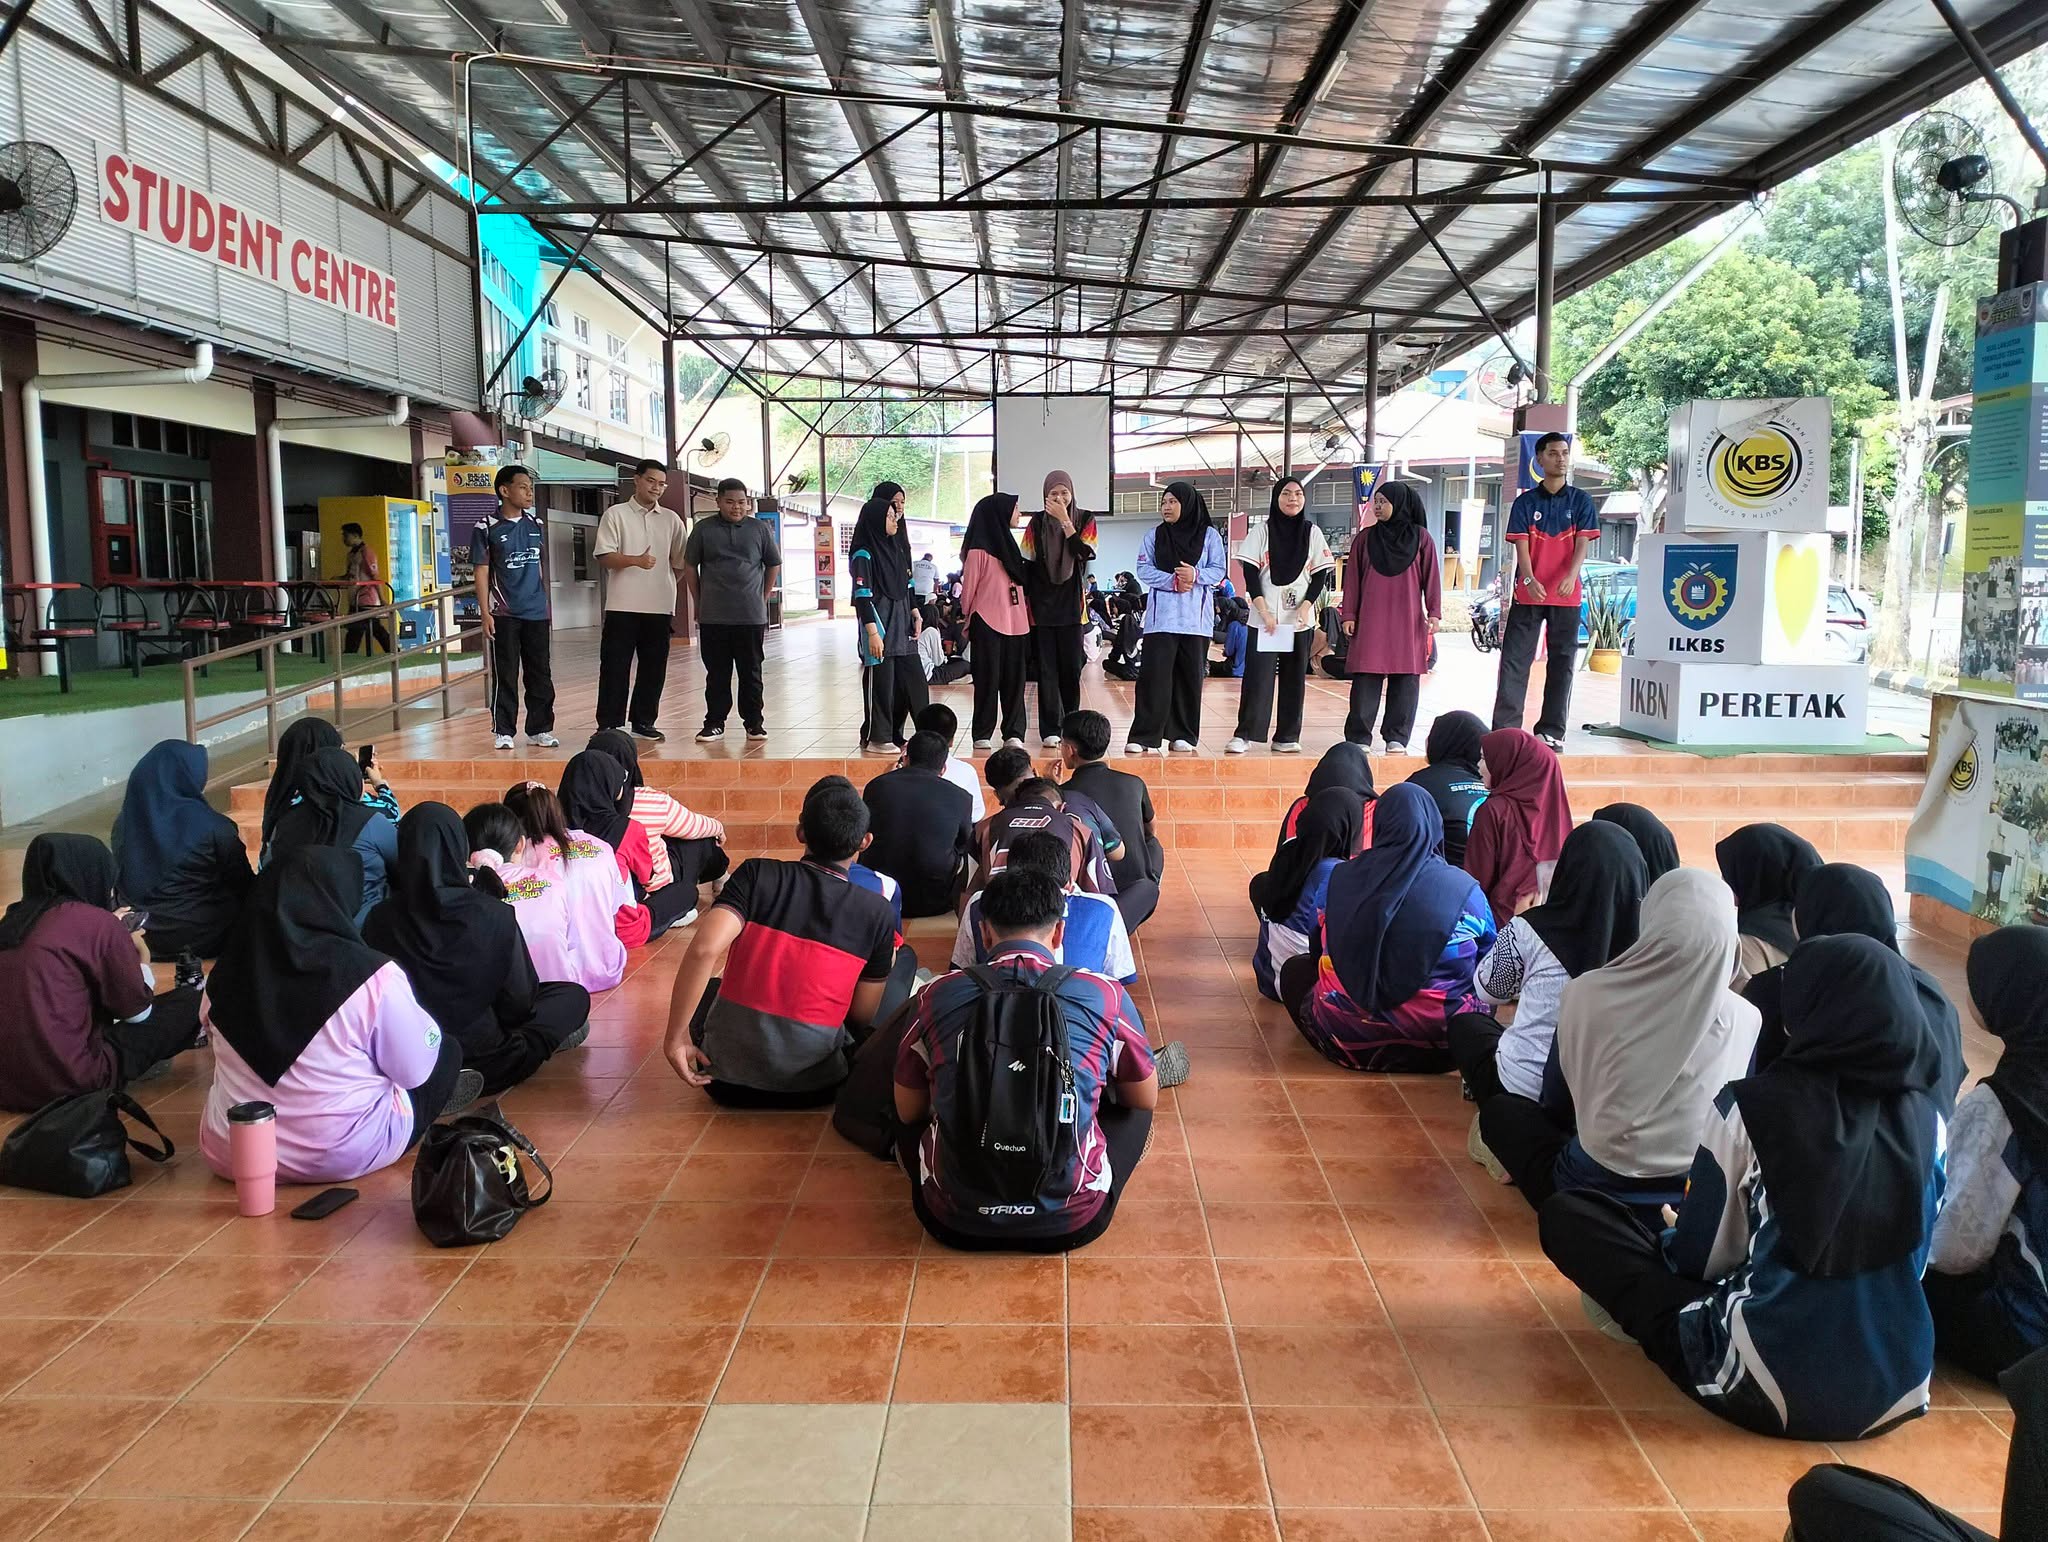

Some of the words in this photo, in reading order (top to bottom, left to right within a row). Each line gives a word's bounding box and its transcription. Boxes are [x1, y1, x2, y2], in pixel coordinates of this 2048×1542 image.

[104, 154, 283, 282] STUDENT
[291, 239, 396, 327] CENTRE
[1781, 415, 1806, 437] SUKAN
[1737, 454, 1785, 475] KBS
[1800, 448, 1815, 494] MINISTRY
[1704, 492, 1736, 516] SPORTS
[1788, 496, 1798, 507] OF
[1752, 507, 1784, 518] YOUTH
[1668, 637, 1725, 653] ILKBS
[1630, 677, 1668, 720] IKBN
[1700, 692, 1846, 719] PERETAK
[994, 1142, 1026, 1152] Quechua
[978, 1205, 1036, 1215] STRIXO
